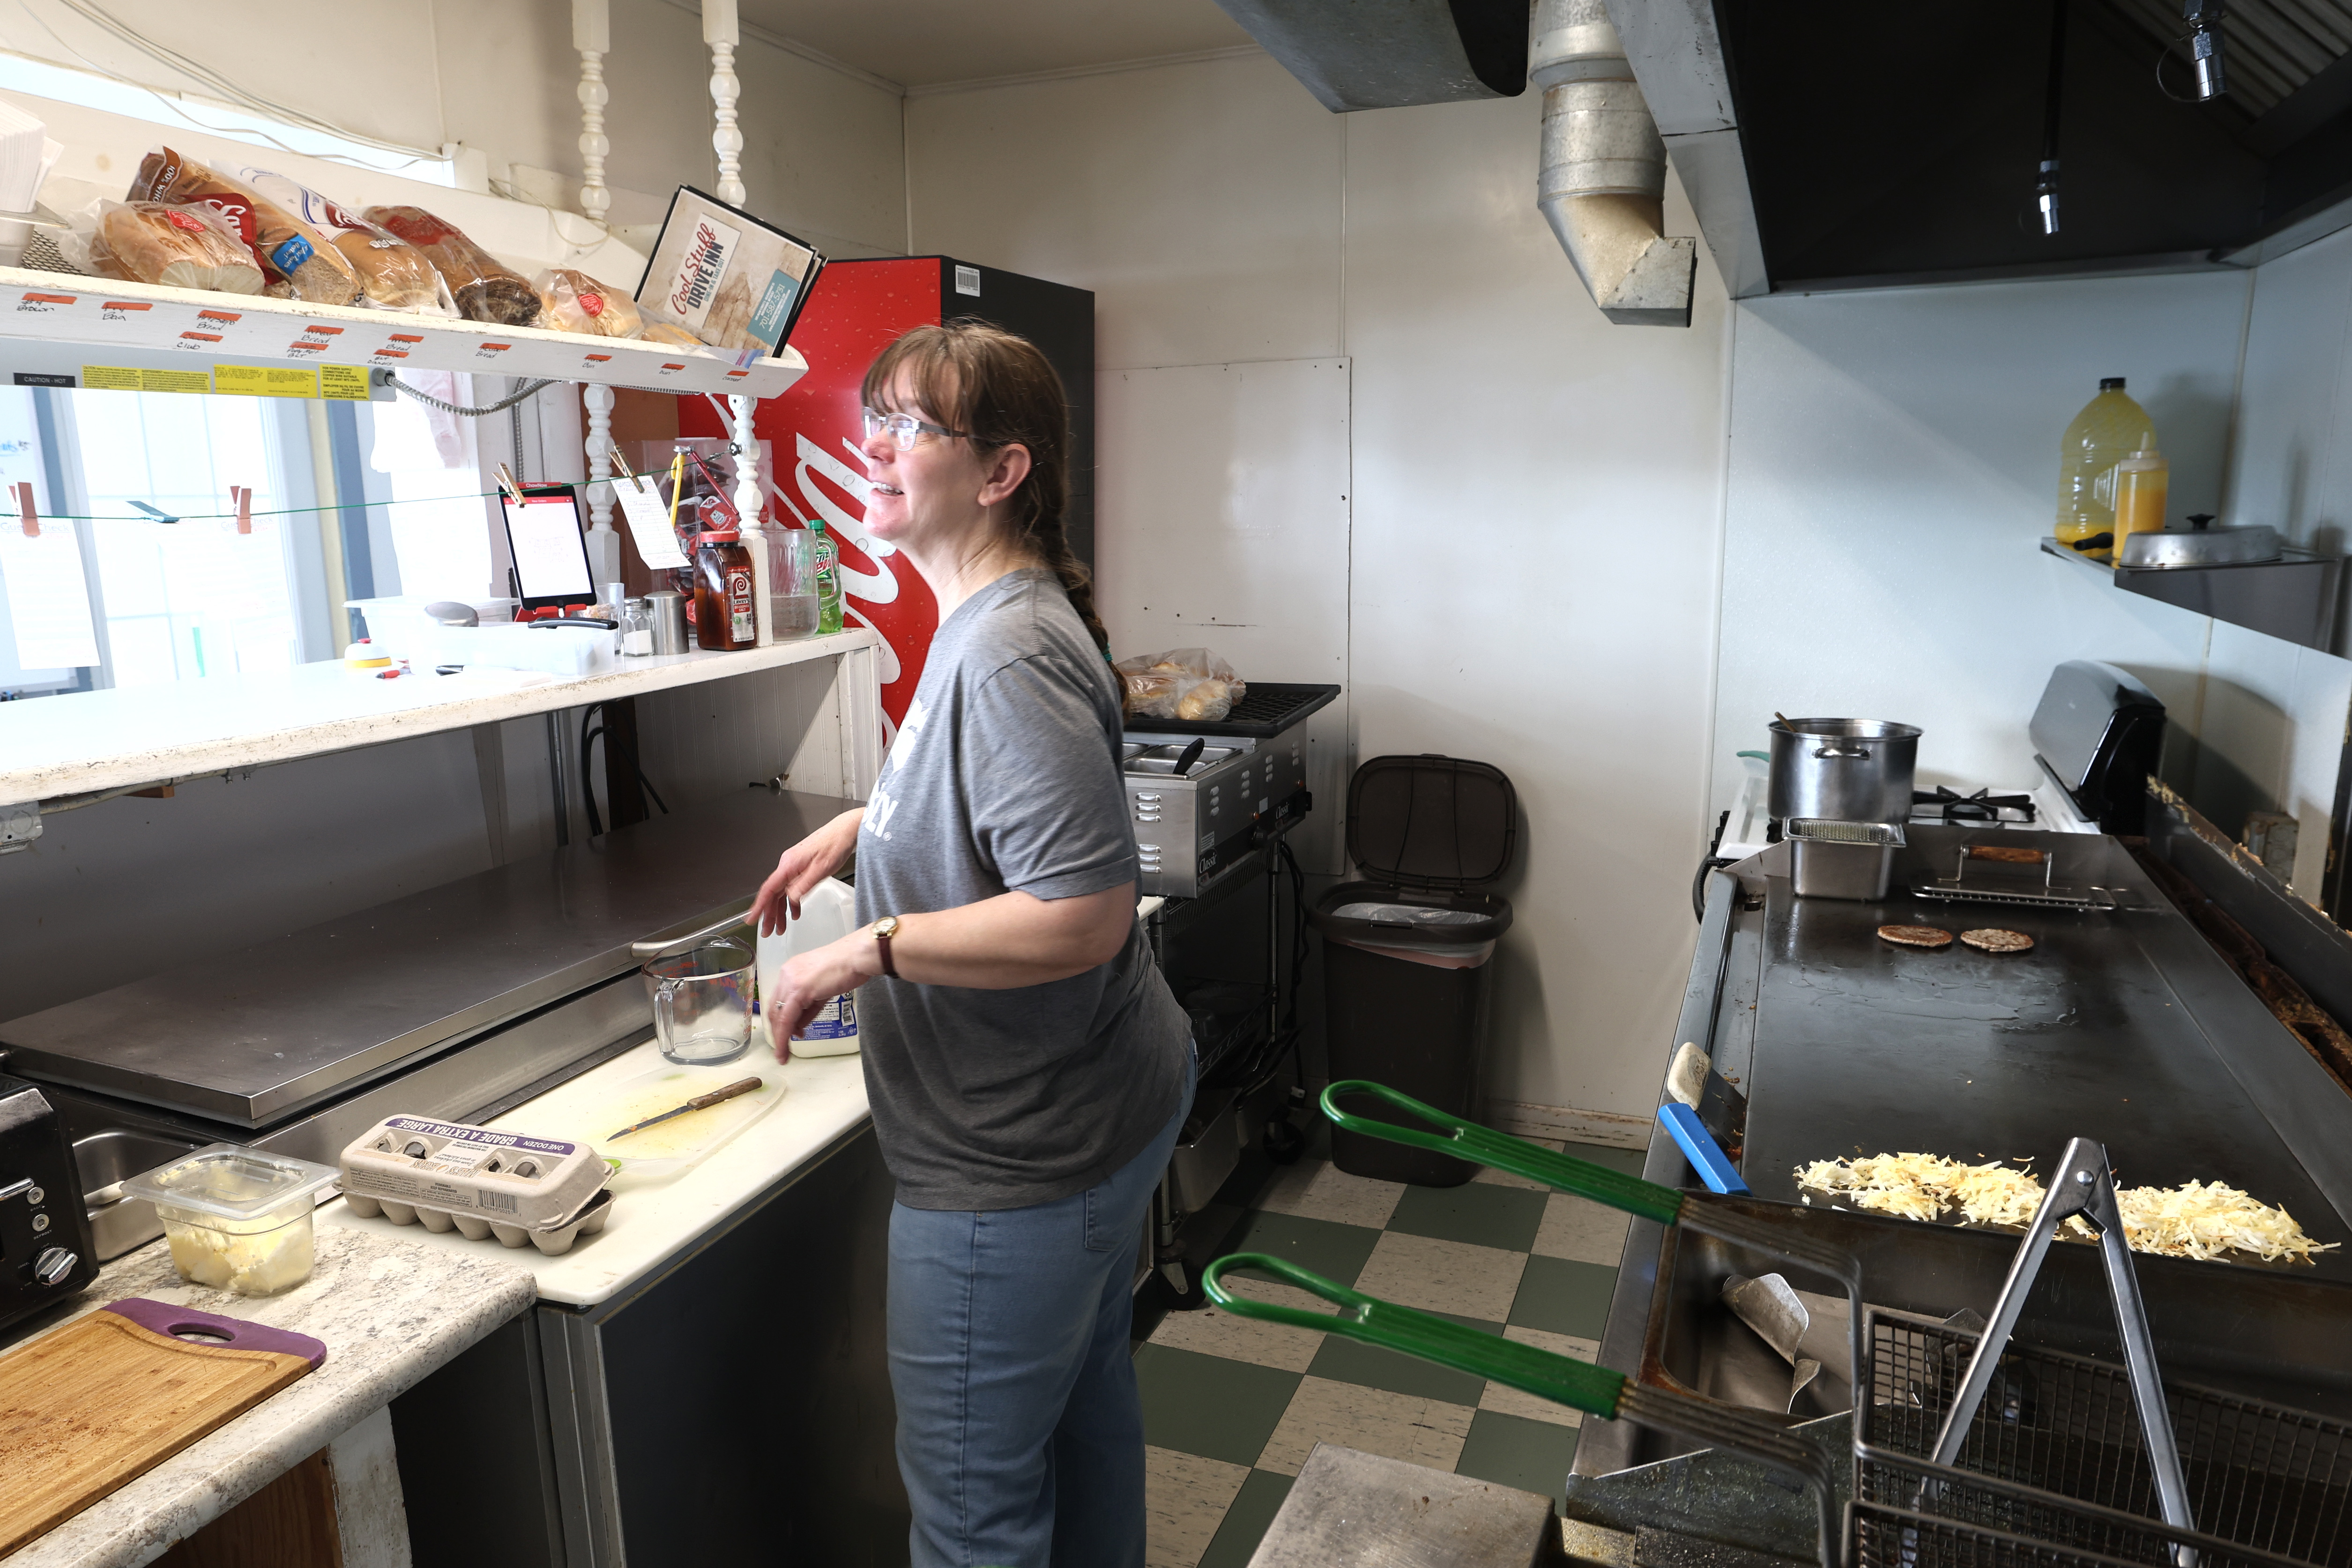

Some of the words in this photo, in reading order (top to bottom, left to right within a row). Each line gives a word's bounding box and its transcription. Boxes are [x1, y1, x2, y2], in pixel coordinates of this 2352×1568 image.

[161, 165, 175, 184] 100%
[152, 184, 166, 202] WHO
[671, 274, 693, 315] Cool
[685, 223, 716, 278] Stuff
[686, 266, 714, 309] DRIVE
[703, 241, 724, 267] INN
[703, 283, 714, 302] DINE-IN
[759, 284, 785, 329] 701-587-5731
[301, 334, 331, 343] Bread
[1199, 852, 1217, 874] Classic
[397, 1119, 432, 1133] LARGE
[432, 1124, 469, 1138] EXTRA
[469, 1131, 478, 1140] A
[478, 1133, 517, 1145] GRADE
[523, 1140, 548, 1149] DOZEN
[409, 1159, 441, 1171] EGGS
[33, 1229, 52, 1240] DEFROST
